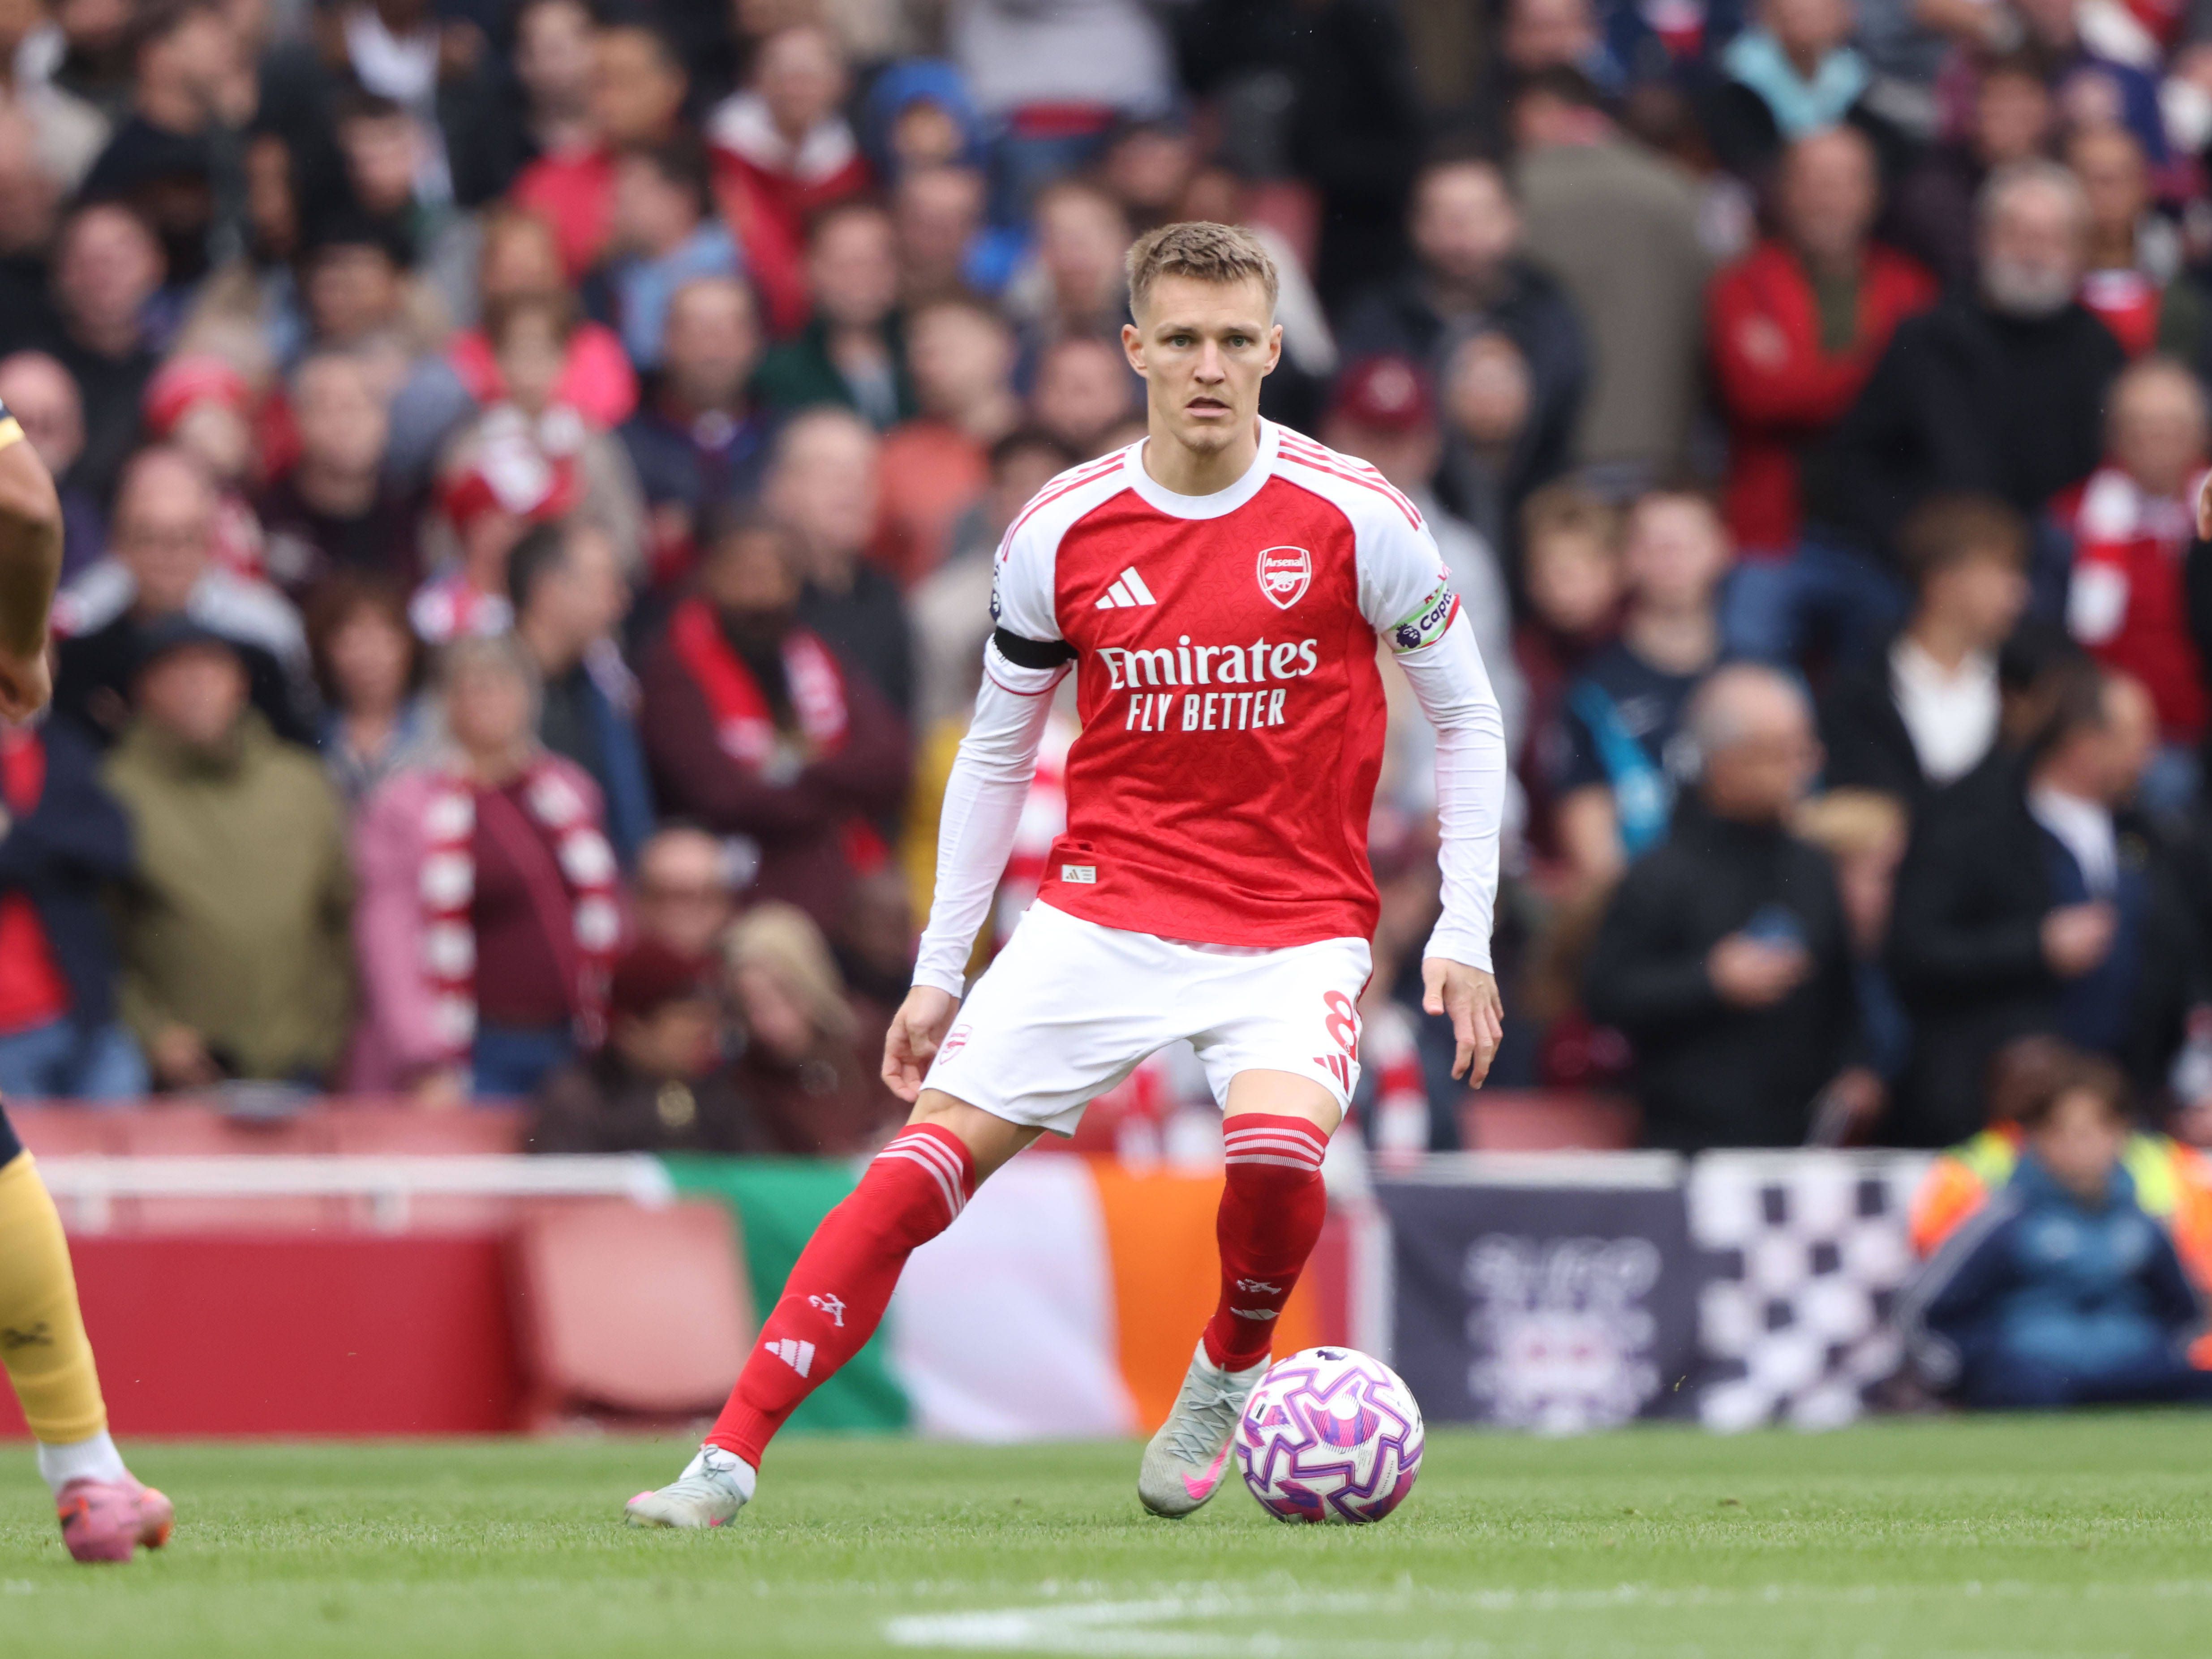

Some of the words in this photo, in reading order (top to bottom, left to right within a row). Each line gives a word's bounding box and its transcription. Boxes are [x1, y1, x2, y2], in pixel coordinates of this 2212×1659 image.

[1265, 557, 1303, 567] Arsenal
[1096, 634, 1318, 690] Emirates
[1125, 693, 1173, 732] FLY
[1182, 688, 1286, 732] BETTER
[1323, 990, 1357, 1062] 8
